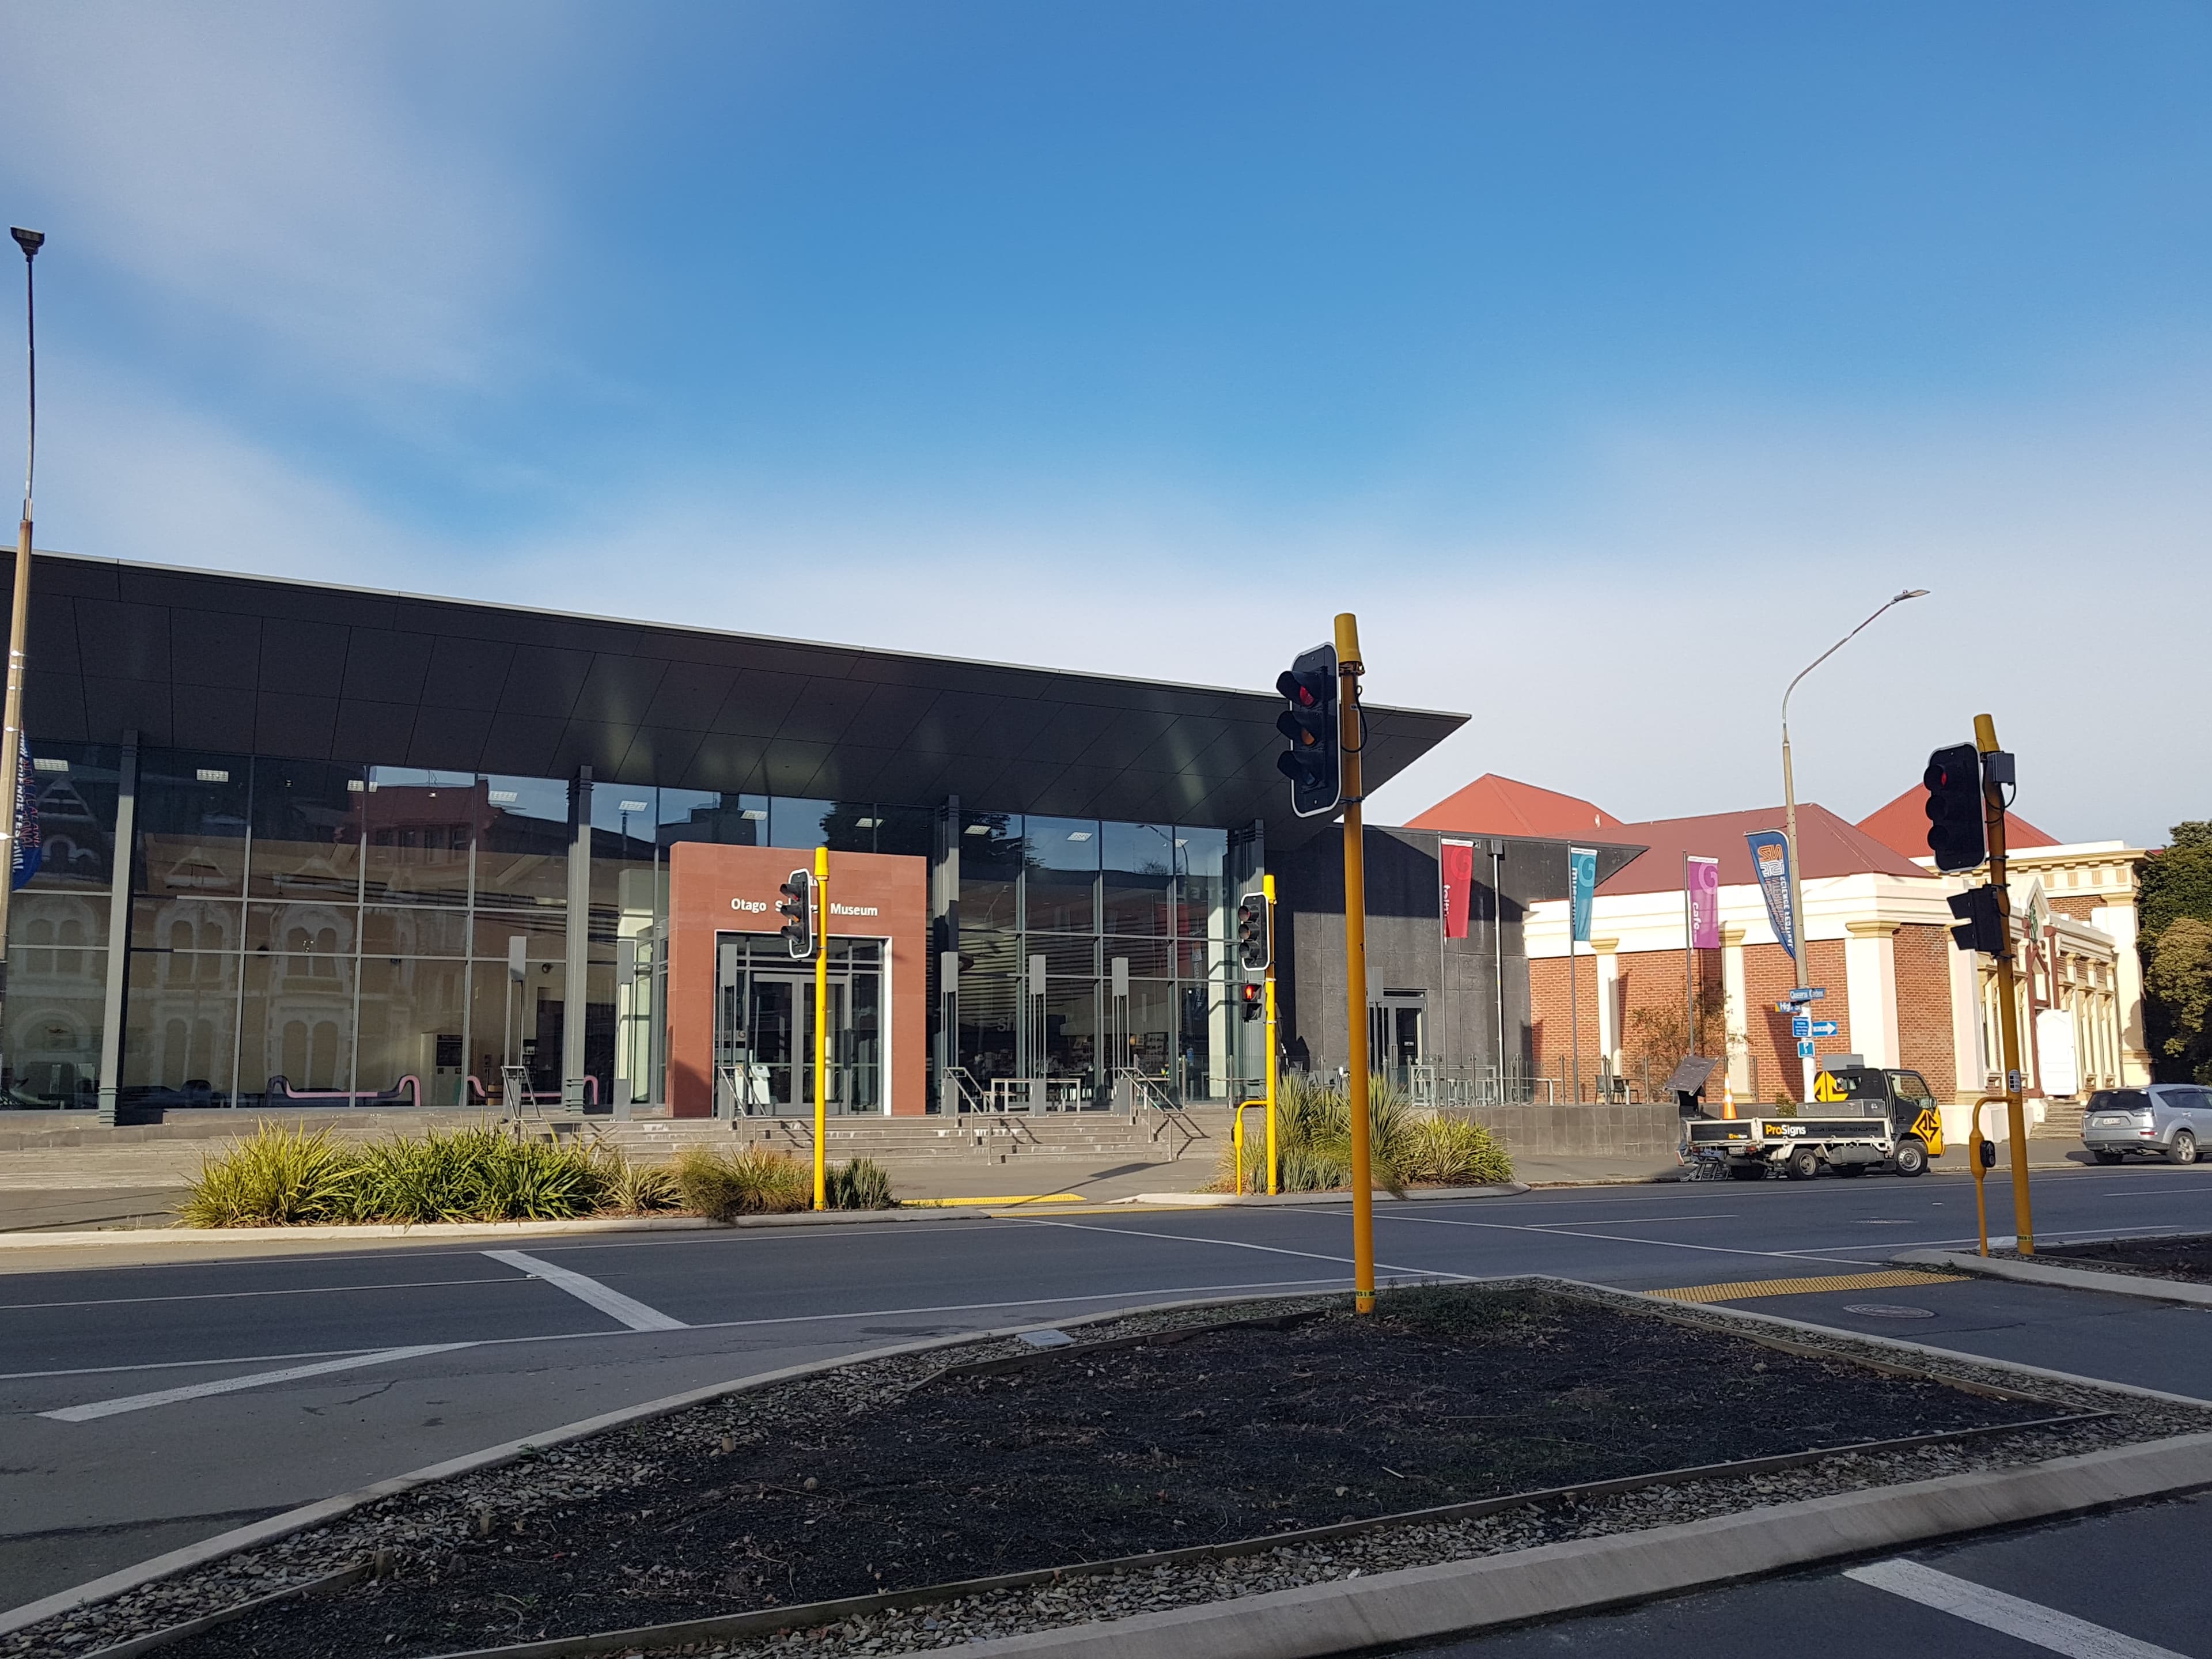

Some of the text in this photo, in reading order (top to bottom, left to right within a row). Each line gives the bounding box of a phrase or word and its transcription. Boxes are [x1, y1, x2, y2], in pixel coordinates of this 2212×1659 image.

[731, 898, 767, 913] Otago
[830, 903, 878, 916] Museum
[1766, 1124, 1806, 1137] ProSigns
